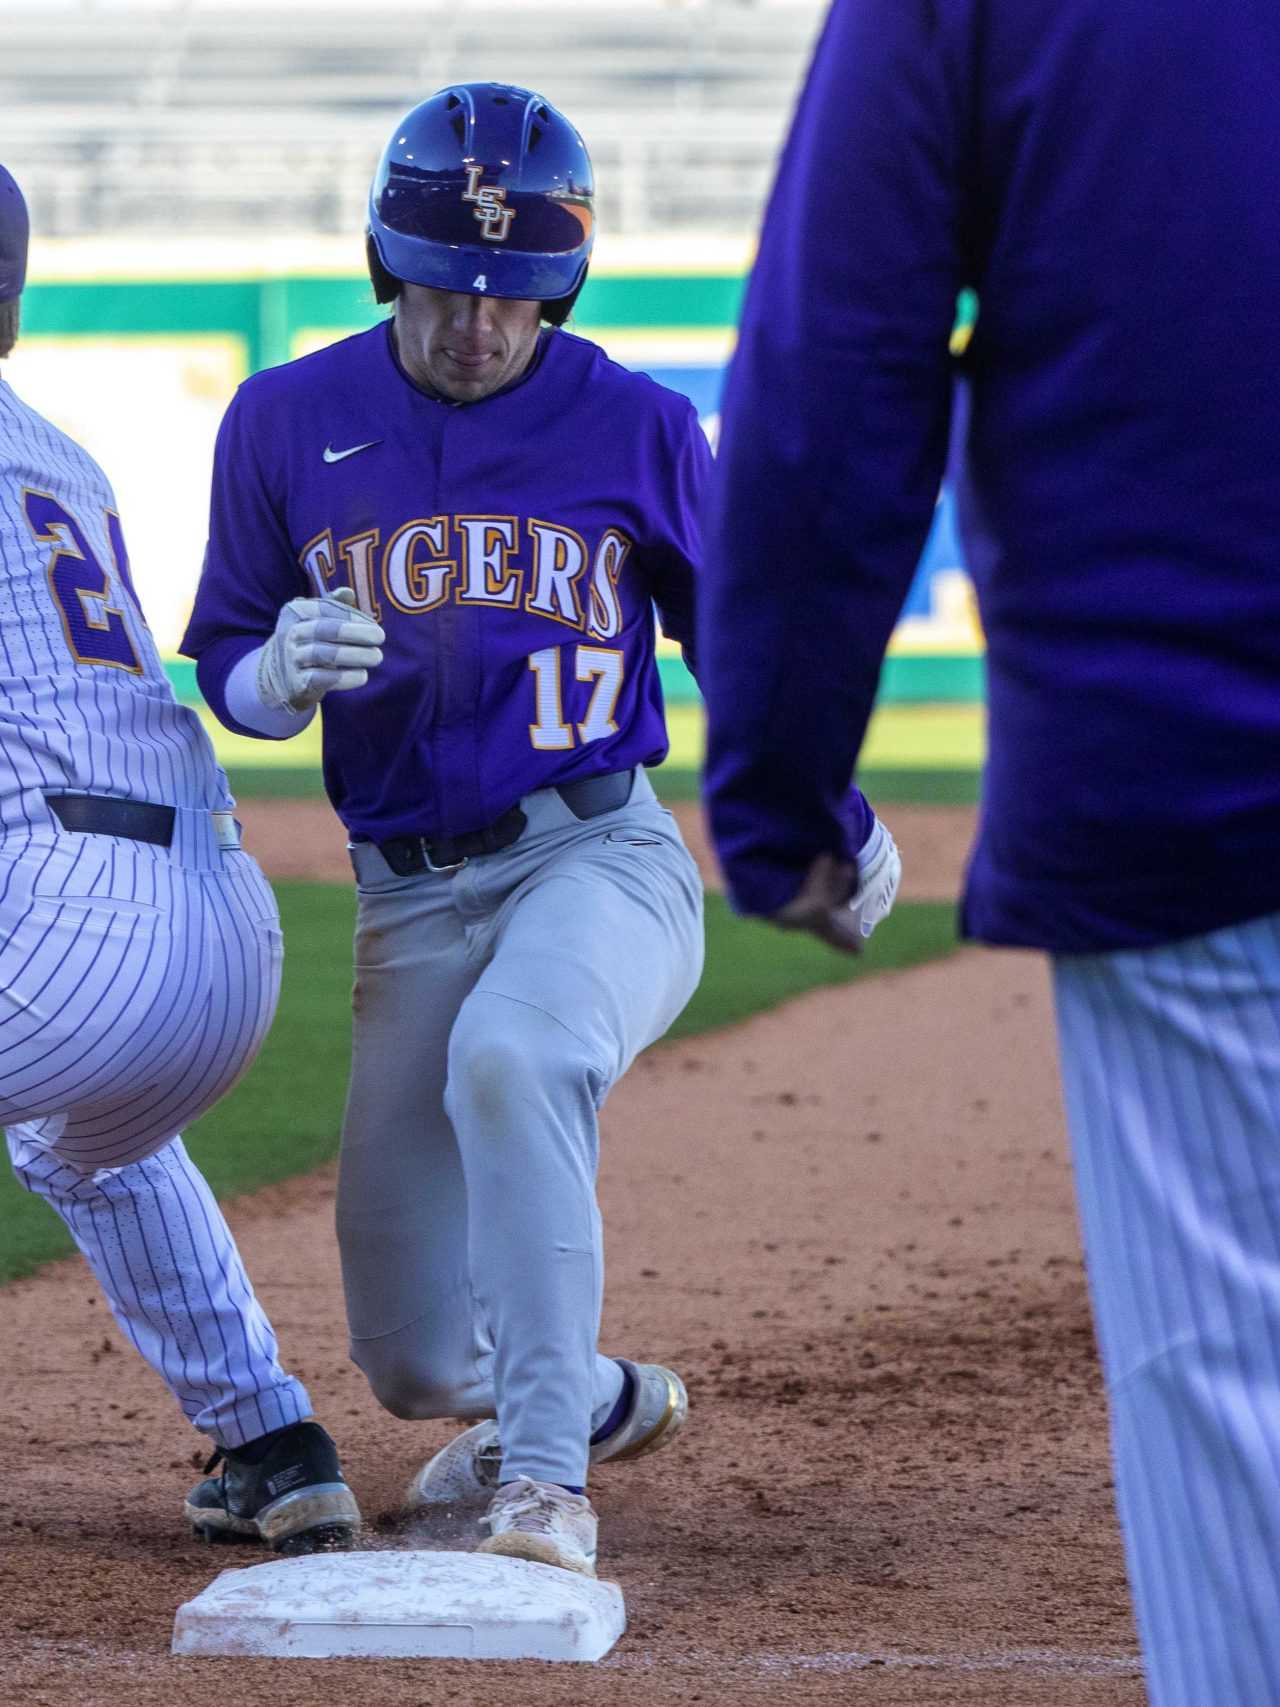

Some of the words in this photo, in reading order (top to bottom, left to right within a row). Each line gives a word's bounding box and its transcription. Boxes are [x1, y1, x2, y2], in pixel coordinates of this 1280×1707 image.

[461, 166, 516, 241] LSU
[473, 274, 487, 291] 4
[22, 487, 148, 676] 2
[528, 644, 625, 750] 17
